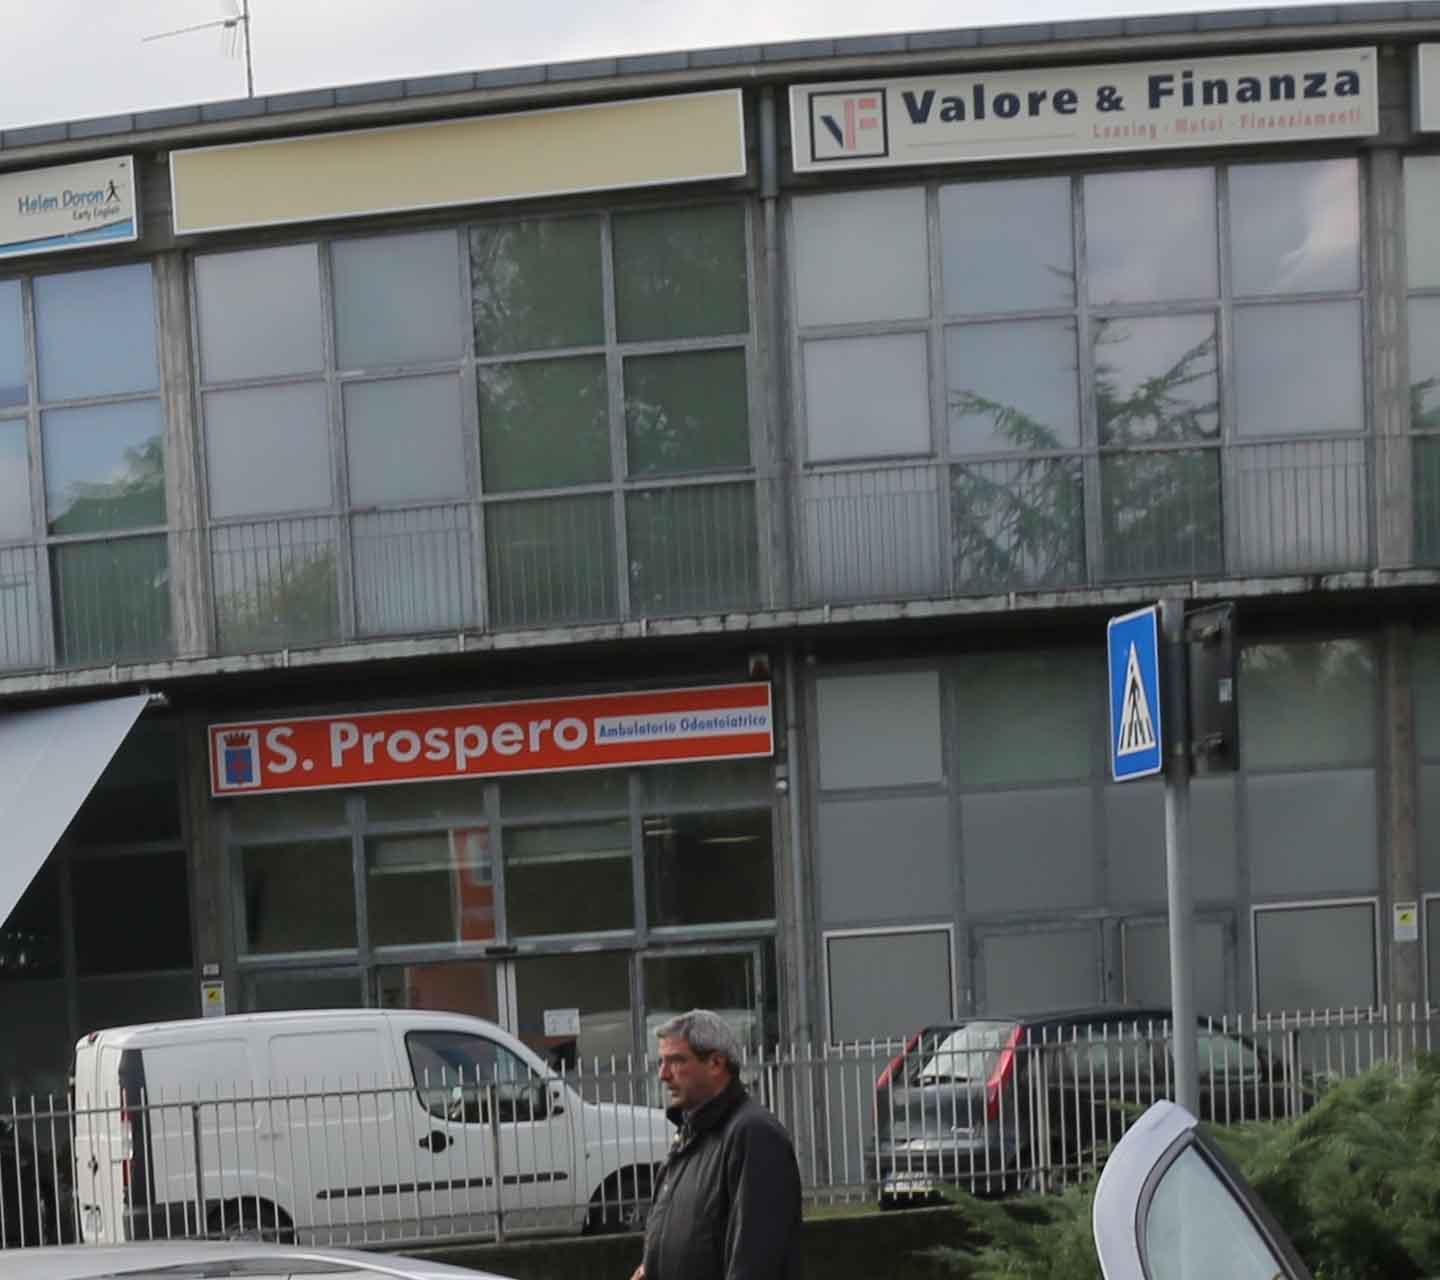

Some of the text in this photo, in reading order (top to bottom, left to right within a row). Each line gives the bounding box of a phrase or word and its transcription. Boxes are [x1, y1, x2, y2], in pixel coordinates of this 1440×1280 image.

[901, 69, 1361, 125] Valore & Finanza
[1092, 122, 1157, 141] Leasing
[1240, 109, 1361, 130] Finanziamenti
[17, 189, 104, 214] Helen Doron
[599, 713, 768, 738] Ambulatorio Odontoiatrico
[265, 716, 589, 775] S. Prospero
